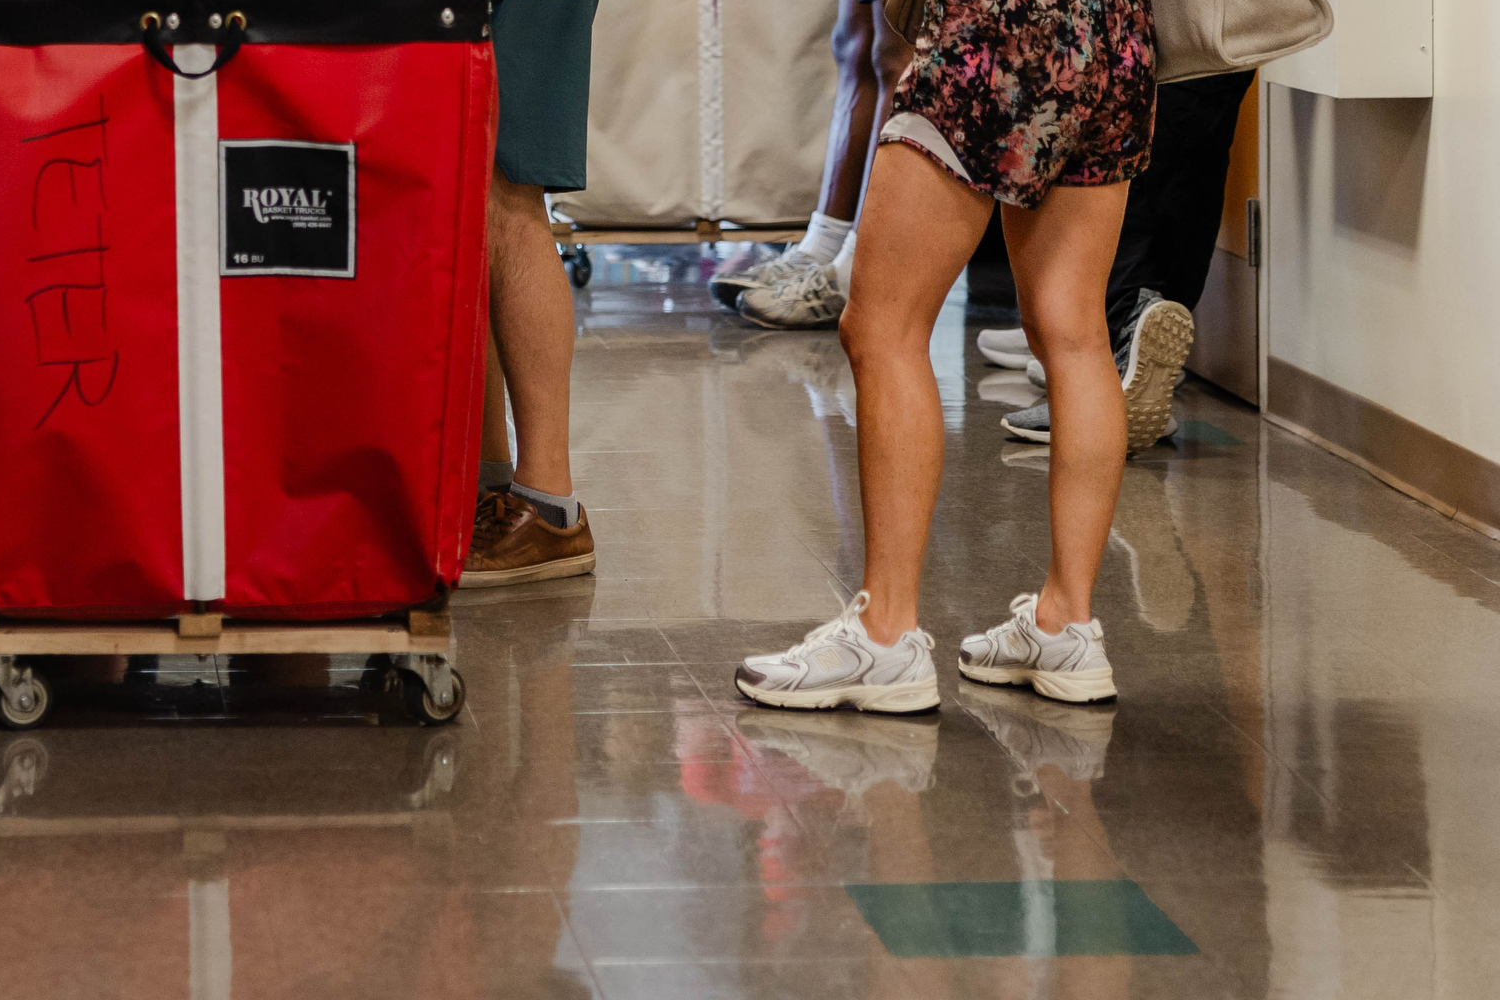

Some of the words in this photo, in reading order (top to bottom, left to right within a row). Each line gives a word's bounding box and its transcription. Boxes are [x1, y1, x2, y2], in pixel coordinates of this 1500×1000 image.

[242, 188, 327, 224] ROYAL
[262, 207, 292, 215] BASKET
[294, 207, 326, 215] TRUCKS
[233, 254, 249, 264] 16
[251, 255, 264, 263] BU
